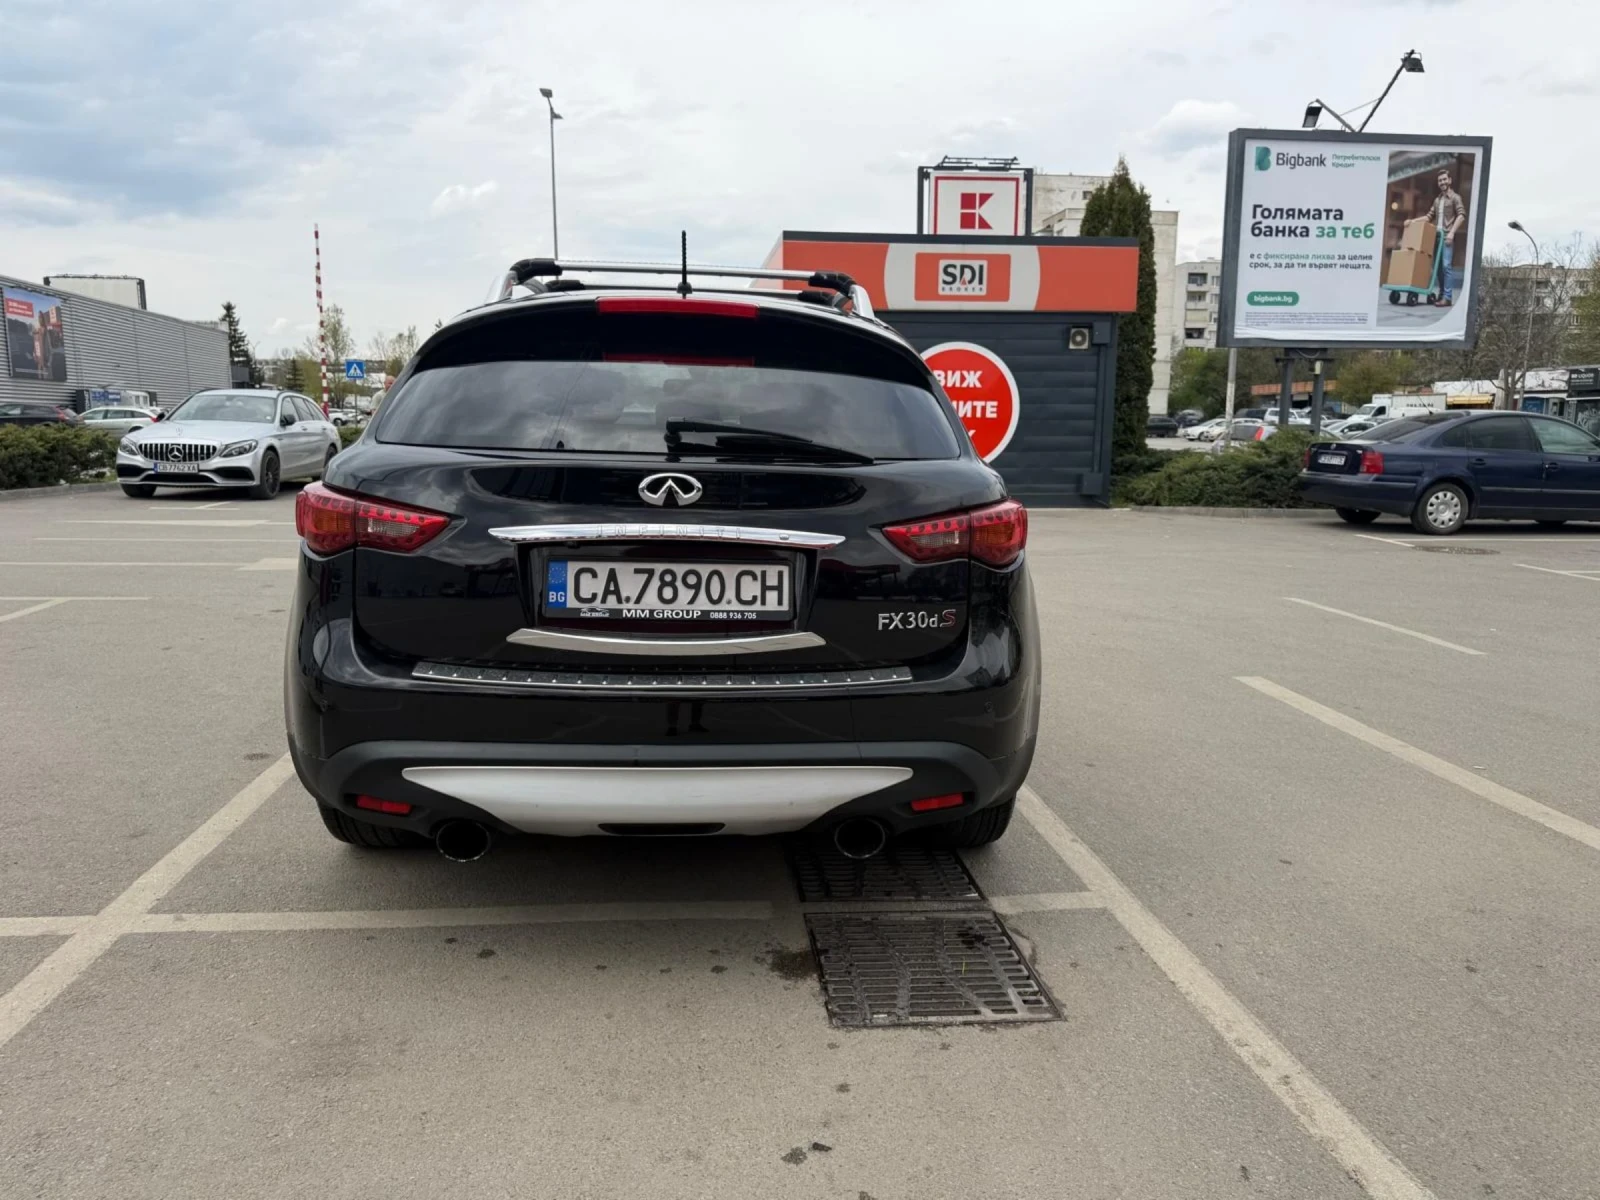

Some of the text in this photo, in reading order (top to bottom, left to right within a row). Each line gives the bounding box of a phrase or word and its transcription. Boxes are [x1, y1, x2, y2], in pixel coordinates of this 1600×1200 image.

[1276, 152, 1327, 170] Bigbank
[1252, 204, 1344, 221] Голямата
[1250, 221, 1375, 239] банка за теб
[1263, 252, 1309, 261] фиксирана
[1347, 254, 1373, 262] целия
[1249, 261, 1272, 270] срок,
[1284, 262, 1295, 270] да
[942, 263, 984, 285] SDI
[1253, 294, 1293, 303] bigbank.bg
[596, 524, 741, 540] INFINITI
[548, 591, 566, 603] BG
[622, 609, 650, 618] MM
[653, 609, 702, 619] GROUP
